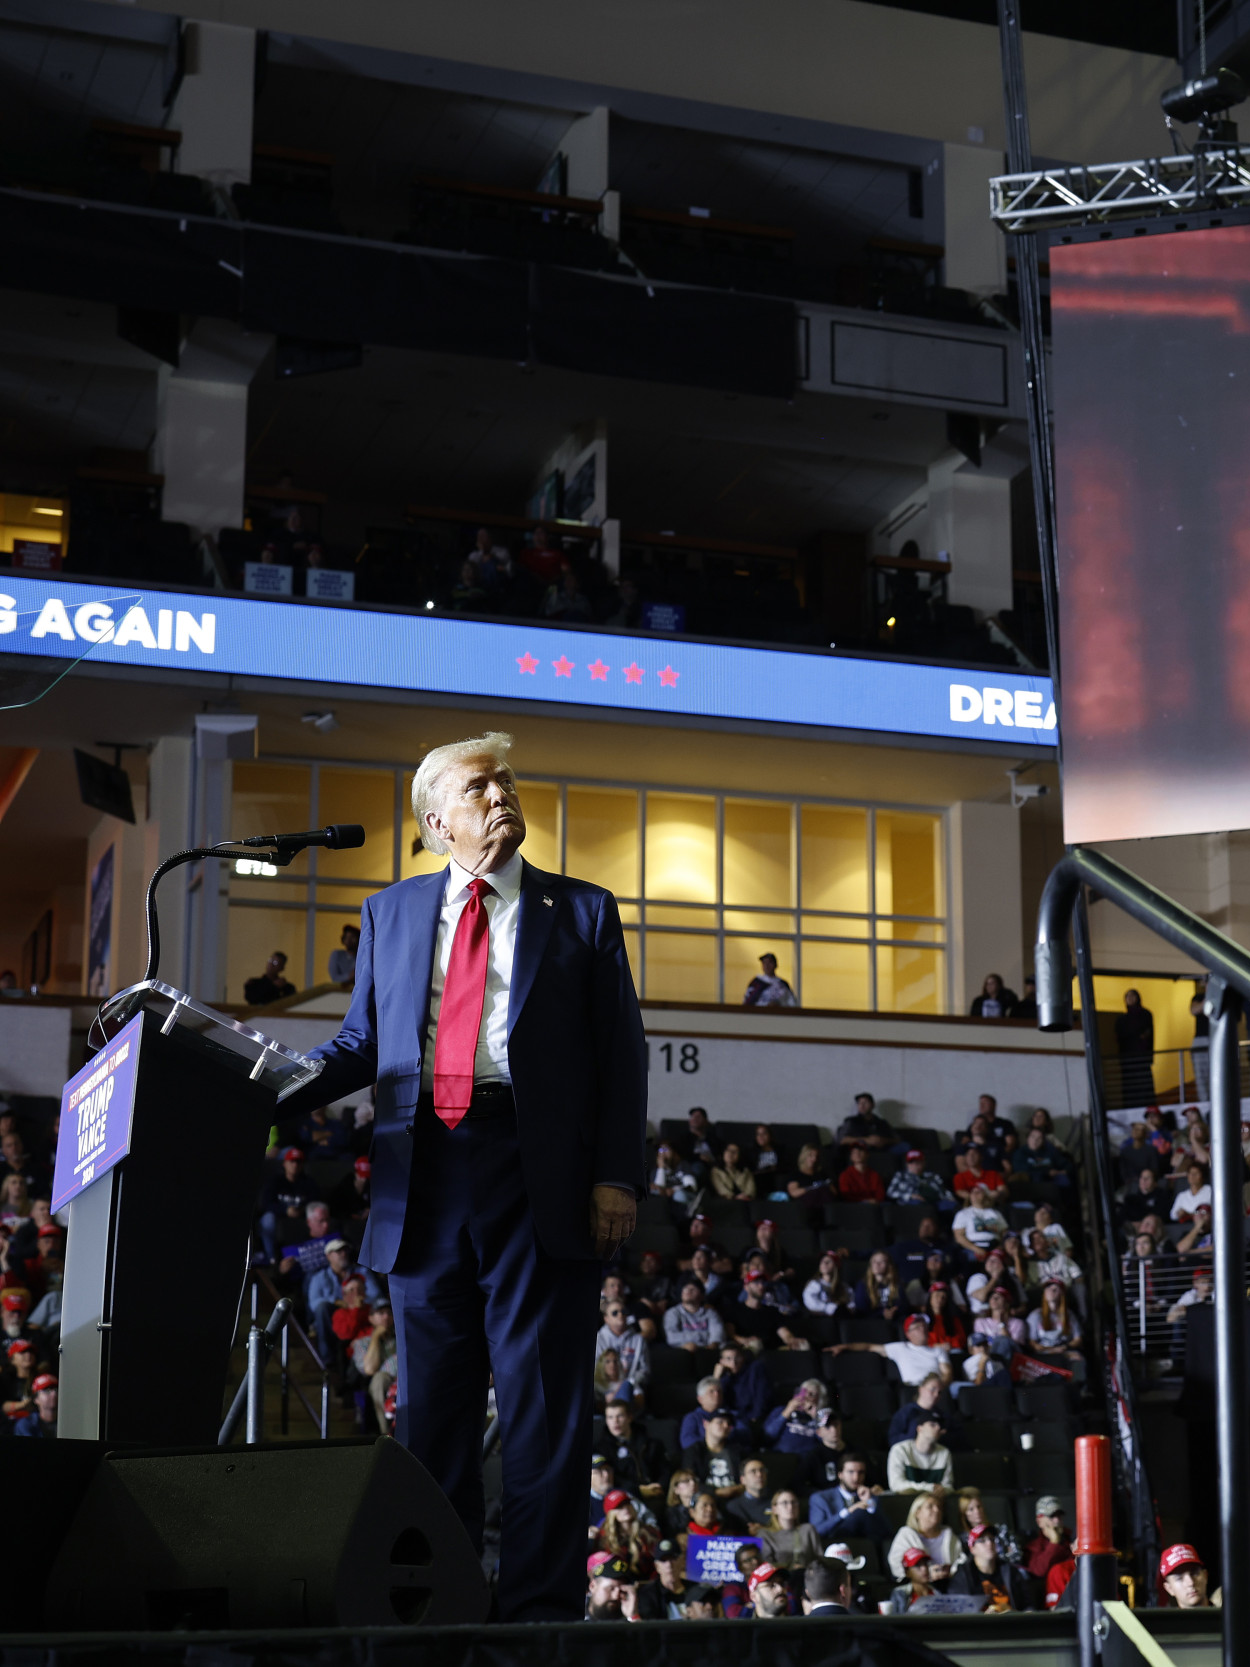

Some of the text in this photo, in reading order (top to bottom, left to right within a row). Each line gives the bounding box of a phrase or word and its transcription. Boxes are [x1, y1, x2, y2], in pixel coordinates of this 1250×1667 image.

[30, 598, 216, 654] AGAIN
[77, 1075, 114, 1136] TRUMP
[78, 1113, 107, 1161] VANCE
[695, 1549, 736, 1562] AMERI
[706, 1540, 743, 1552] MAKE
[702, 1560, 738, 1573] GREA
